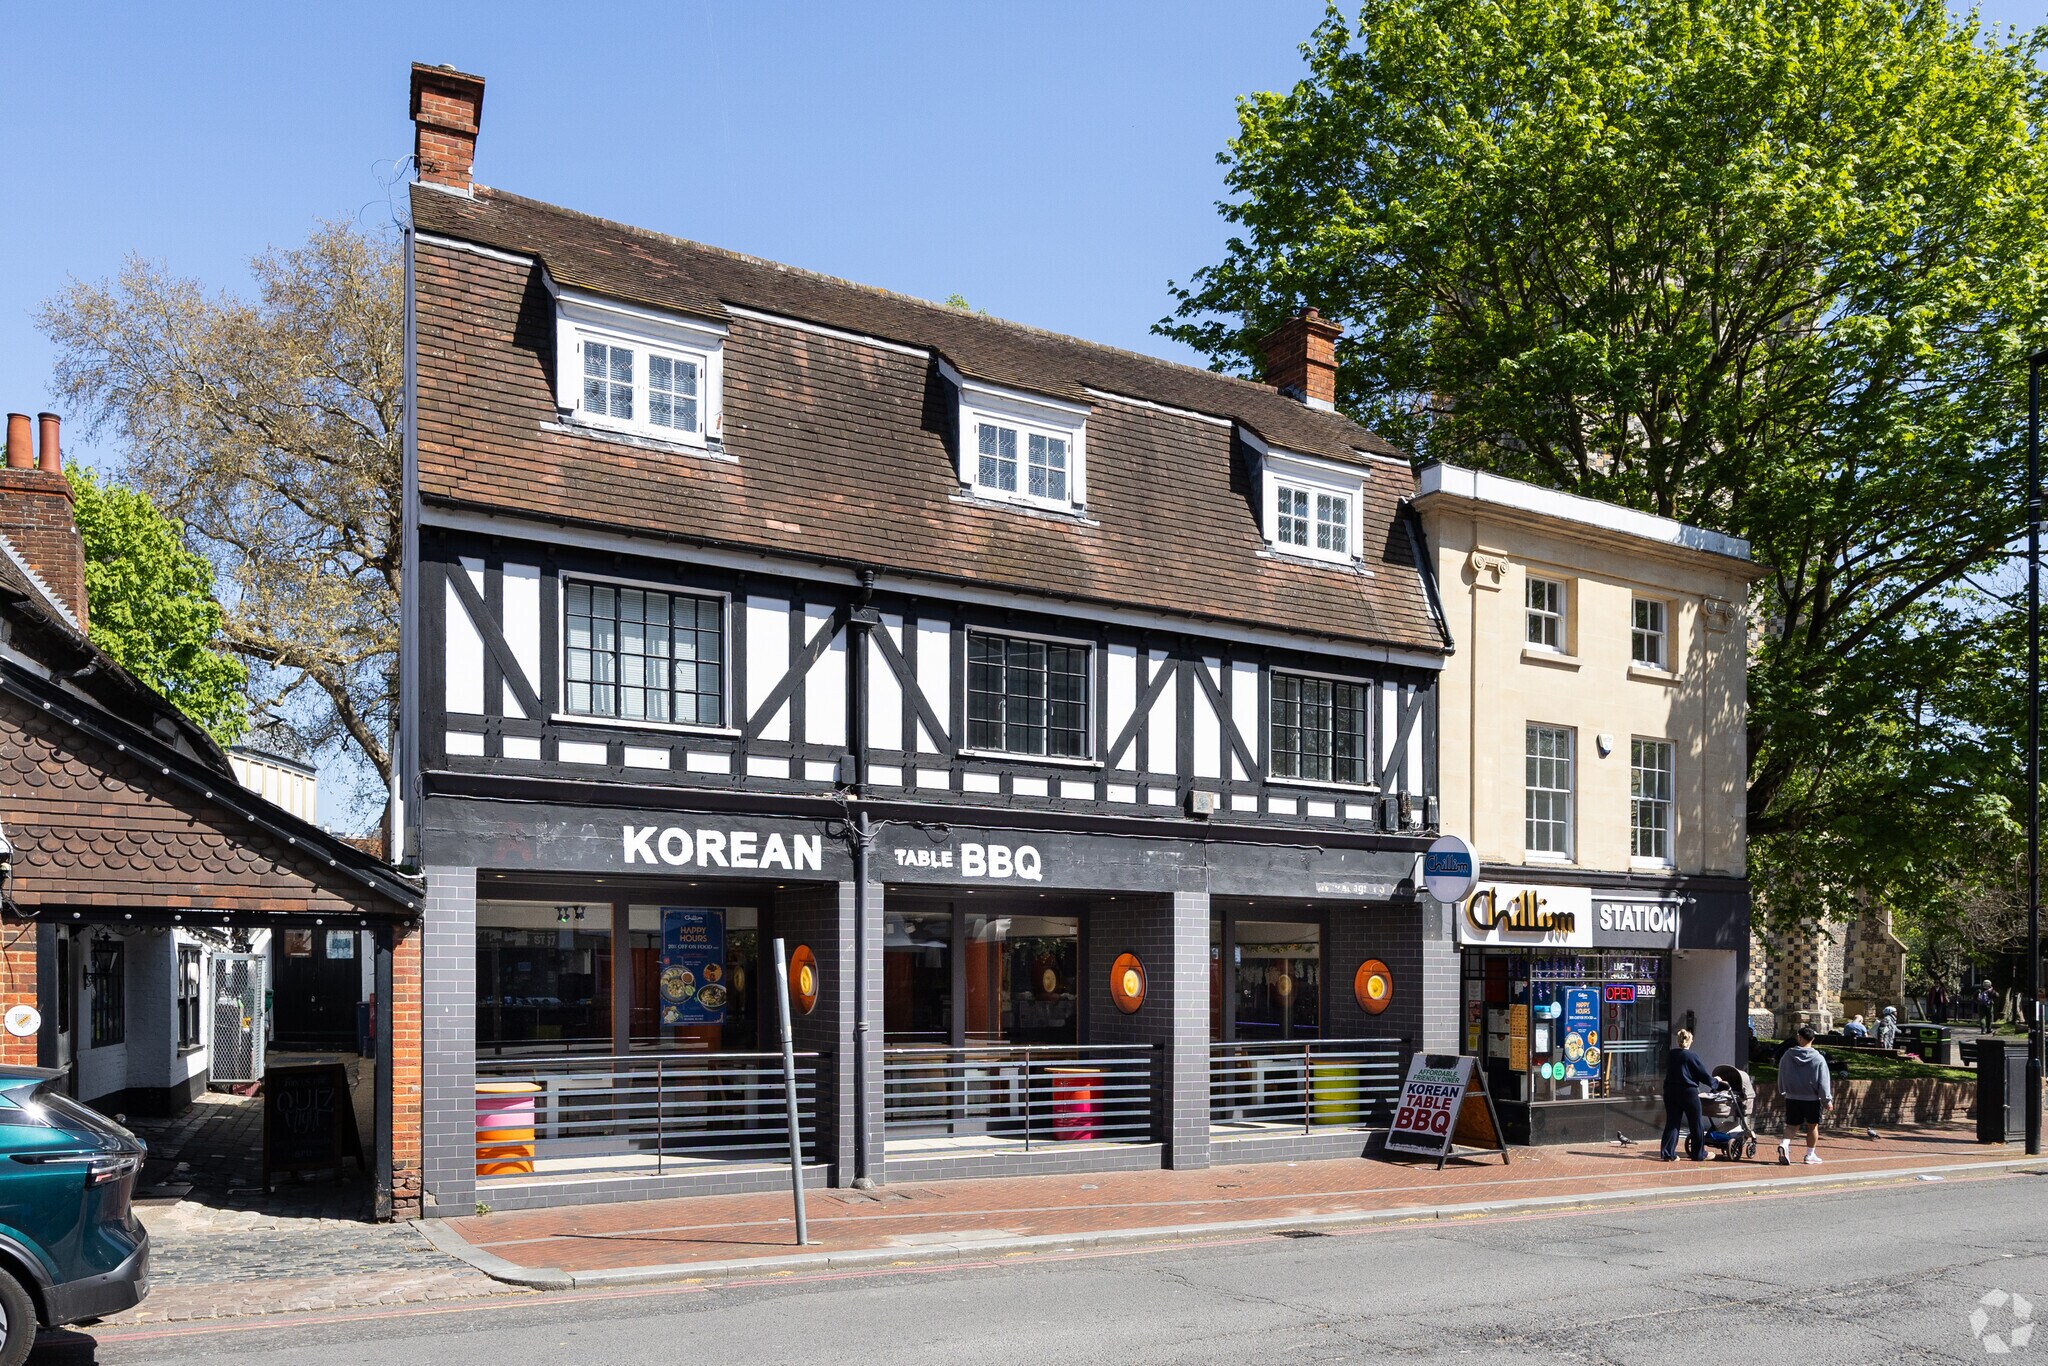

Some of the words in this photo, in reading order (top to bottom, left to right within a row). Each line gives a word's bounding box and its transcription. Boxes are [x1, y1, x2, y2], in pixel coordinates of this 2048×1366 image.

[623, 825, 822, 871] KOREAN
[894, 849, 953, 868] TABLE
[961, 843, 1043, 882] BBQ
[1600, 904, 1675, 932] STATION
[680, 934, 707, 942] HOURS
[1613, 962, 1625, 971] LIVE
[1606, 987, 1633, 1000] OPEN
[1413, 1074, 1441, 1082] FRIENDLY
[1418, 1069, 1458, 1077] AFFORDABLE
[1407, 1083, 1459, 1098] KOREAN
[276, 1087, 334, 1113] QUIZ
[1407, 1095, 1452, 1110] TABLE
[1395, 1107, 1451, 1136] BBQ
